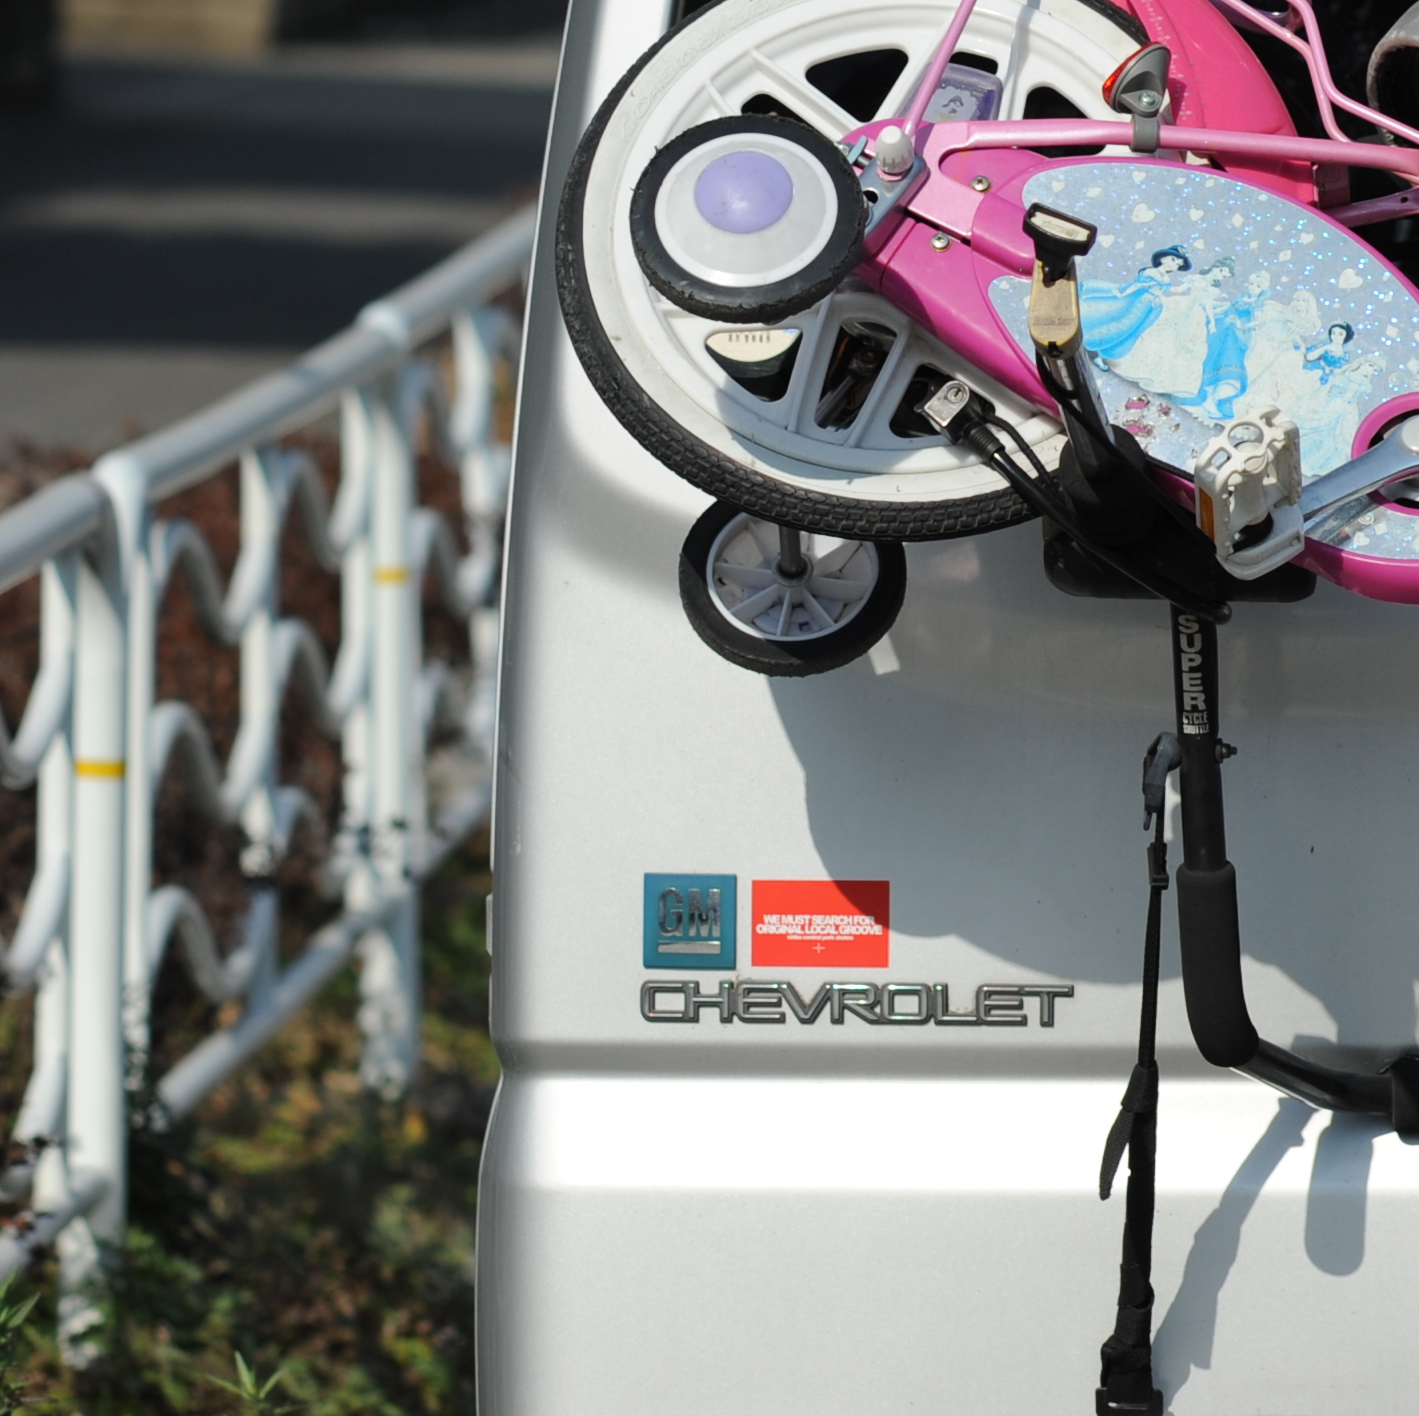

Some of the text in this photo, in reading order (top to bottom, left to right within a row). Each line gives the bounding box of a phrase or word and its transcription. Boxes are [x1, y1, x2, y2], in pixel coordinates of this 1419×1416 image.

[1178, 614, 1206, 711] SUPER
[658, 886, 721, 937] GM
[756, 923, 883, 935] ORIGINAL LOCAL GROOVE
[763, 914, 875, 926] WE MUST SEARCH FOR
[640, 980, 1074, 1027] CHEVROLET
